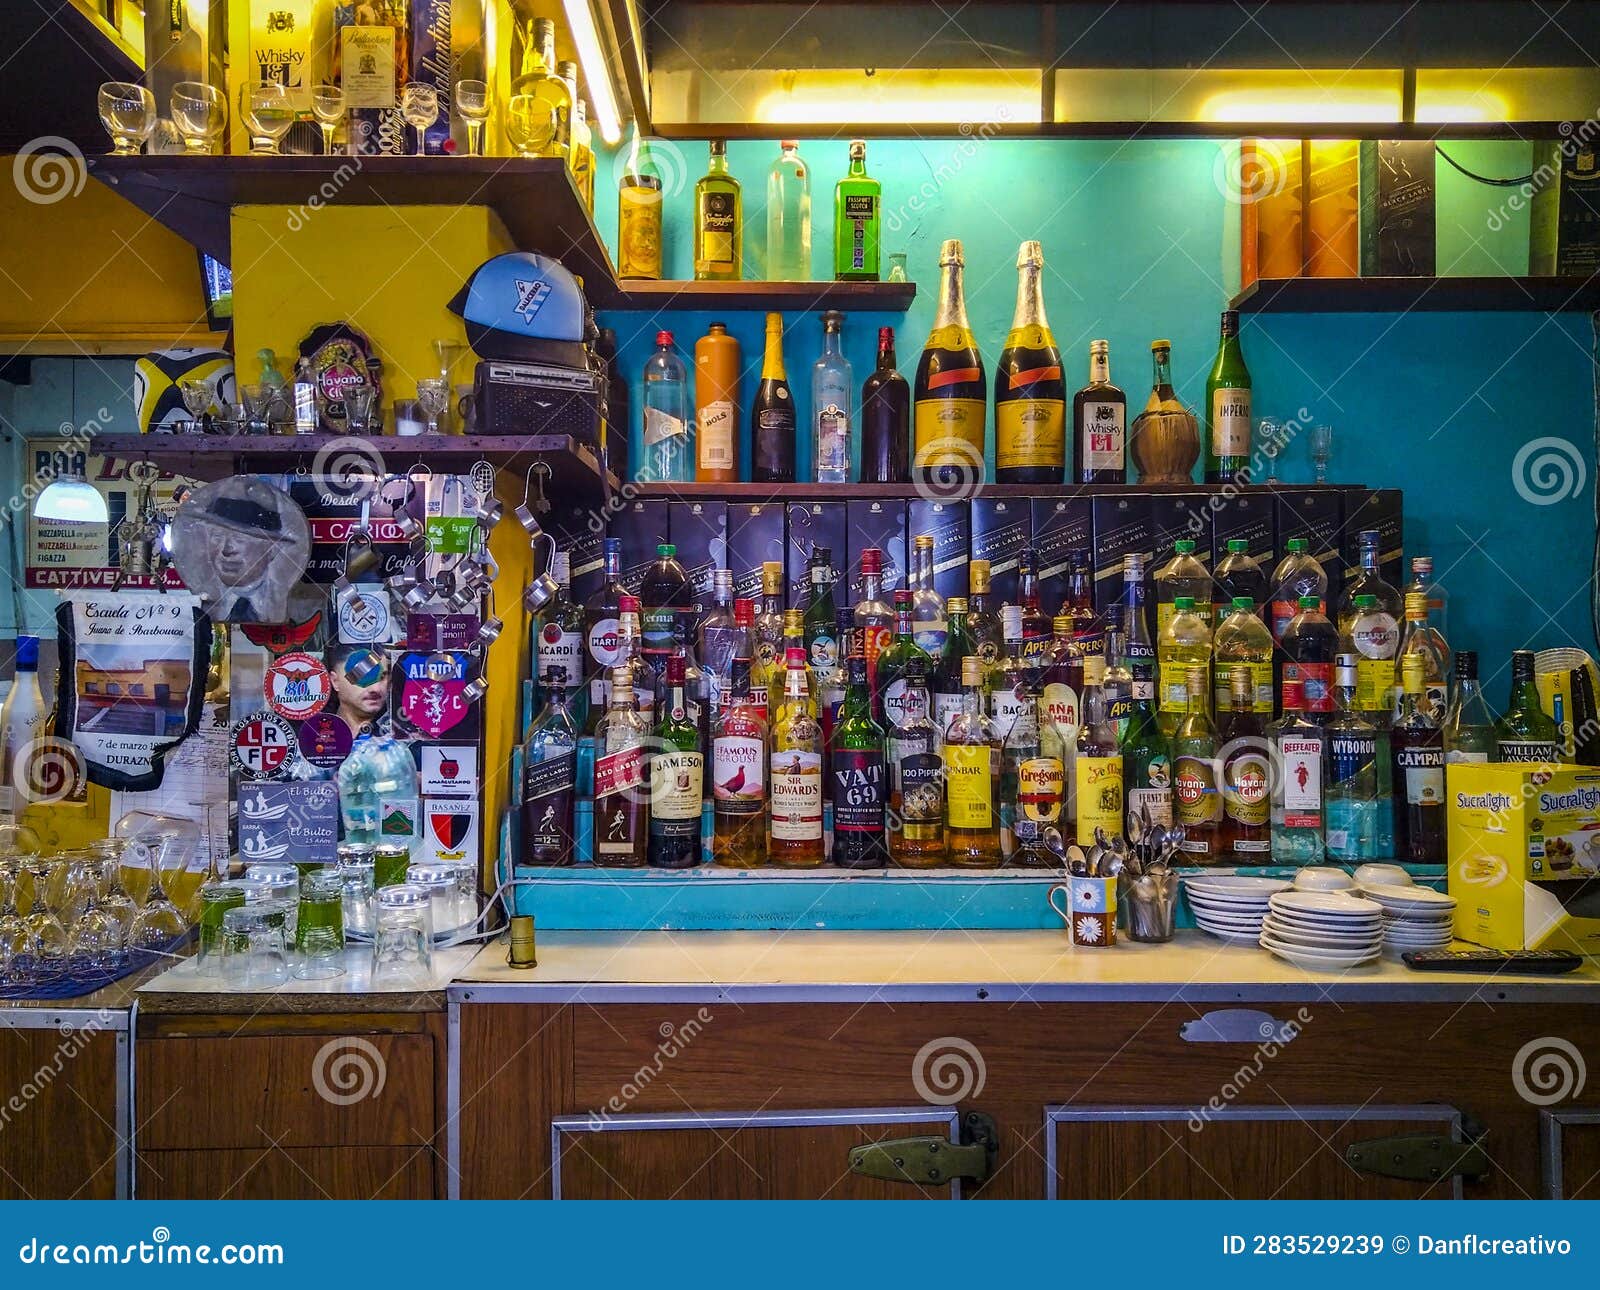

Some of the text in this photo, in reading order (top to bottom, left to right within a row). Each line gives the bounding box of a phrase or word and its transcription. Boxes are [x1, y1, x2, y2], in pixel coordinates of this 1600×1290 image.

[256, 48, 305, 65] Whisky
[705, 412, 727, 427] BOLS
[1086, 423, 1121, 436] Whisky
[321, 494, 359, 506] Desde
[939, 535, 963, 546] LABEL
[975, 534, 1026, 555] BLACK LABEL
[1062, 533, 1087, 545] LABEL
[1099, 532, 1148, 553] BLACK LABEL
[38, 554, 66, 562] FIGAZZA
[85, 603, 130, 618] Escuela
[171, 607, 181, 618] 9
[115, 624, 125, 634] de
[409, 663, 462, 679] ALBION
[285, 681, 309, 697] 80
[274, 694, 327, 704] Aniversario
[409, 695, 462, 709] F C
[98, 739, 147, 751] 7 de marzo
[1284, 743, 1320, 753] BEEFEATER
[1503, 746, 1552, 755] WILLIAM
[720, 746, 757, 756] FAMOUS
[721, 755, 756, 763] GROUSE
[528, 774, 549, 784] BLACK
[549, 766, 571, 776] LABEL
[596, 760, 640, 779] RED LABEL
[903, 769, 916, 778] 100
[948, 766, 982, 775] UNBAR
[787, 776, 801, 785] SIR
[835, 765, 883, 788] VAT
[1235, 777, 1268, 788] Havana
[1179, 788, 1197, 798] Club
[1242, 787, 1263, 798] Club
[1456, 792, 1512, 812] Sucralight
[1540, 787, 1600, 811] Sucraligh
[432, 802, 471, 811] BASAÑEZ
[303, 827, 333, 836] Bulto
[543, 836, 551, 844] 12
